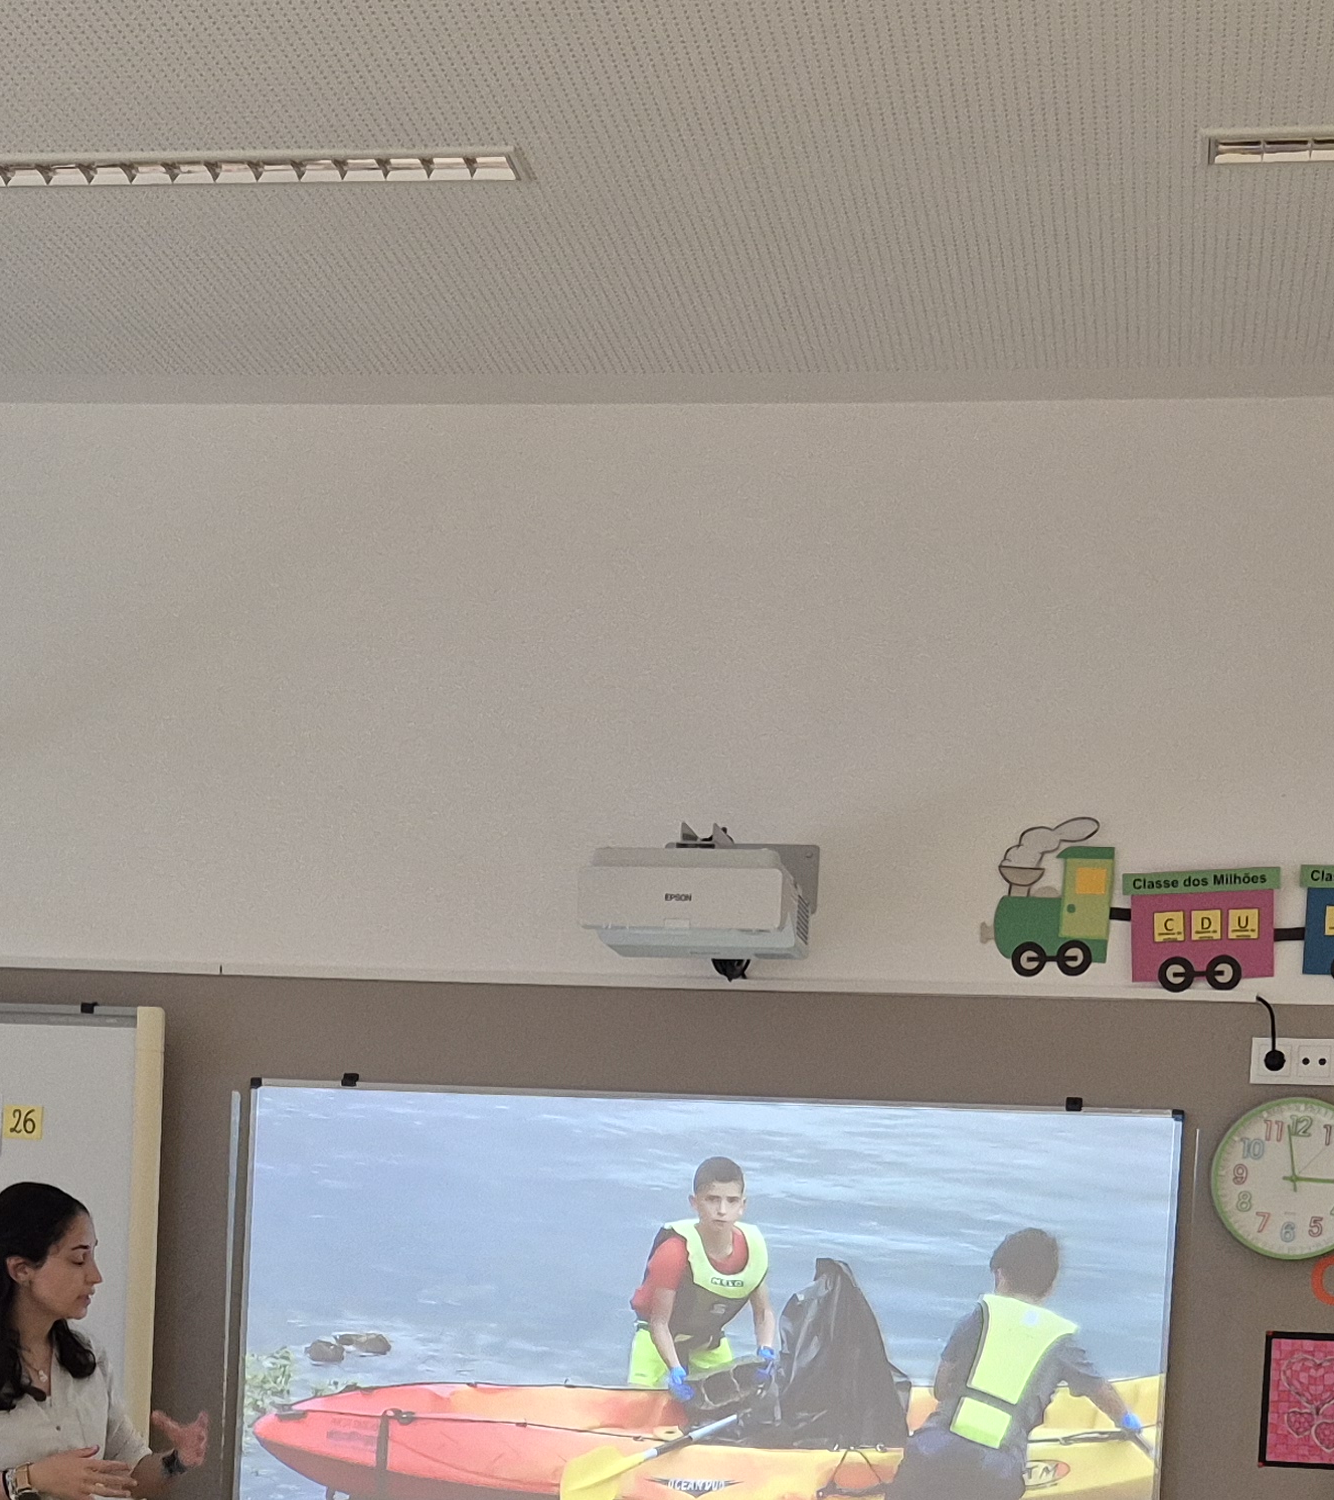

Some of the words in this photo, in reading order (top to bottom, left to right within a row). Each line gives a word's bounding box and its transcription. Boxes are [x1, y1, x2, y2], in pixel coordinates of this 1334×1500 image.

[1132, 877, 1179, 891] Classe
[1183, 875, 1209, 889] dos
[1213, 871, 1267, 887] Milhões
[664, 892, 692, 902] EPSON
[1163, 917, 1174, 932] C
[1200, 916, 1212, 931] D
[1237, 914, 1249, 929] U
[1264, 1119, 1284, 1142] 11
[1289, 1115, 1313, 1138] 12
[1323, 1124, 1332, 1146] 1
[1240, 1137, 1265, 1160] 10
[1232, 1163, 1248, 1186] 9
[1235, 1190, 1252, 1212] 8
[1255, 1211, 1271, 1233] 7
[1280, 1221, 1296, 1243] 6
[1308, 1216, 1324, 1238] 5
[668, 1479, 703, 1491] OCEAN
